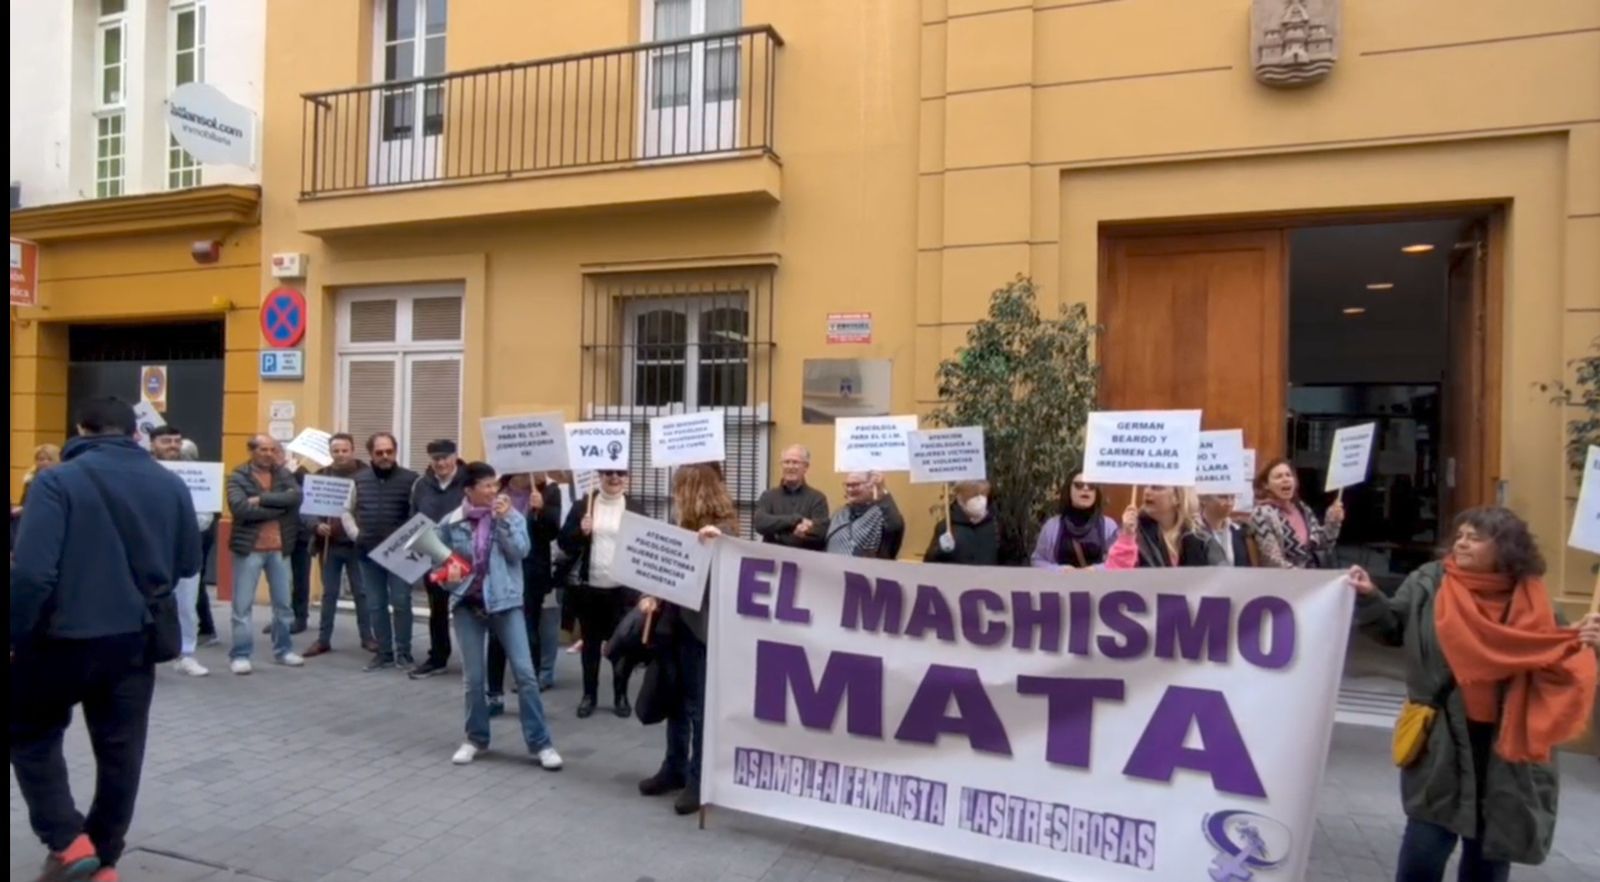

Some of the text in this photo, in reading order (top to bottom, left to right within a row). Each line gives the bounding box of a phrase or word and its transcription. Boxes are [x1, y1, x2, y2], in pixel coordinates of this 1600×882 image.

[1117, 421, 1164, 430] GERMÁN
[1112, 435, 1156, 443] BEARDO
[580, 445, 604, 457] YA!
[1100, 448, 1178, 457] CARMEN LARA
[1096, 460, 1179, 469] IRRESPONSABLES
[1202, 464, 1229, 472] LARA
[626, 544, 659, 560] MUJERES
[631, 557, 685, 580] DE VIOLENCIAS
[636, 569, 676, 587] MACHISTAS
[737, 556, 1297, 671] EL MACHISMO
[754, 639, 1268, 799] MATA
[734, 747, 840, 804] ASAMBLEA
[841, 765, 947, 826] FEMINISTA
[959, 786, 1007, 840] LAS
[1006, 795, 1070, 853] TRES
[1070, 807, 1156, 871] ROSAS
